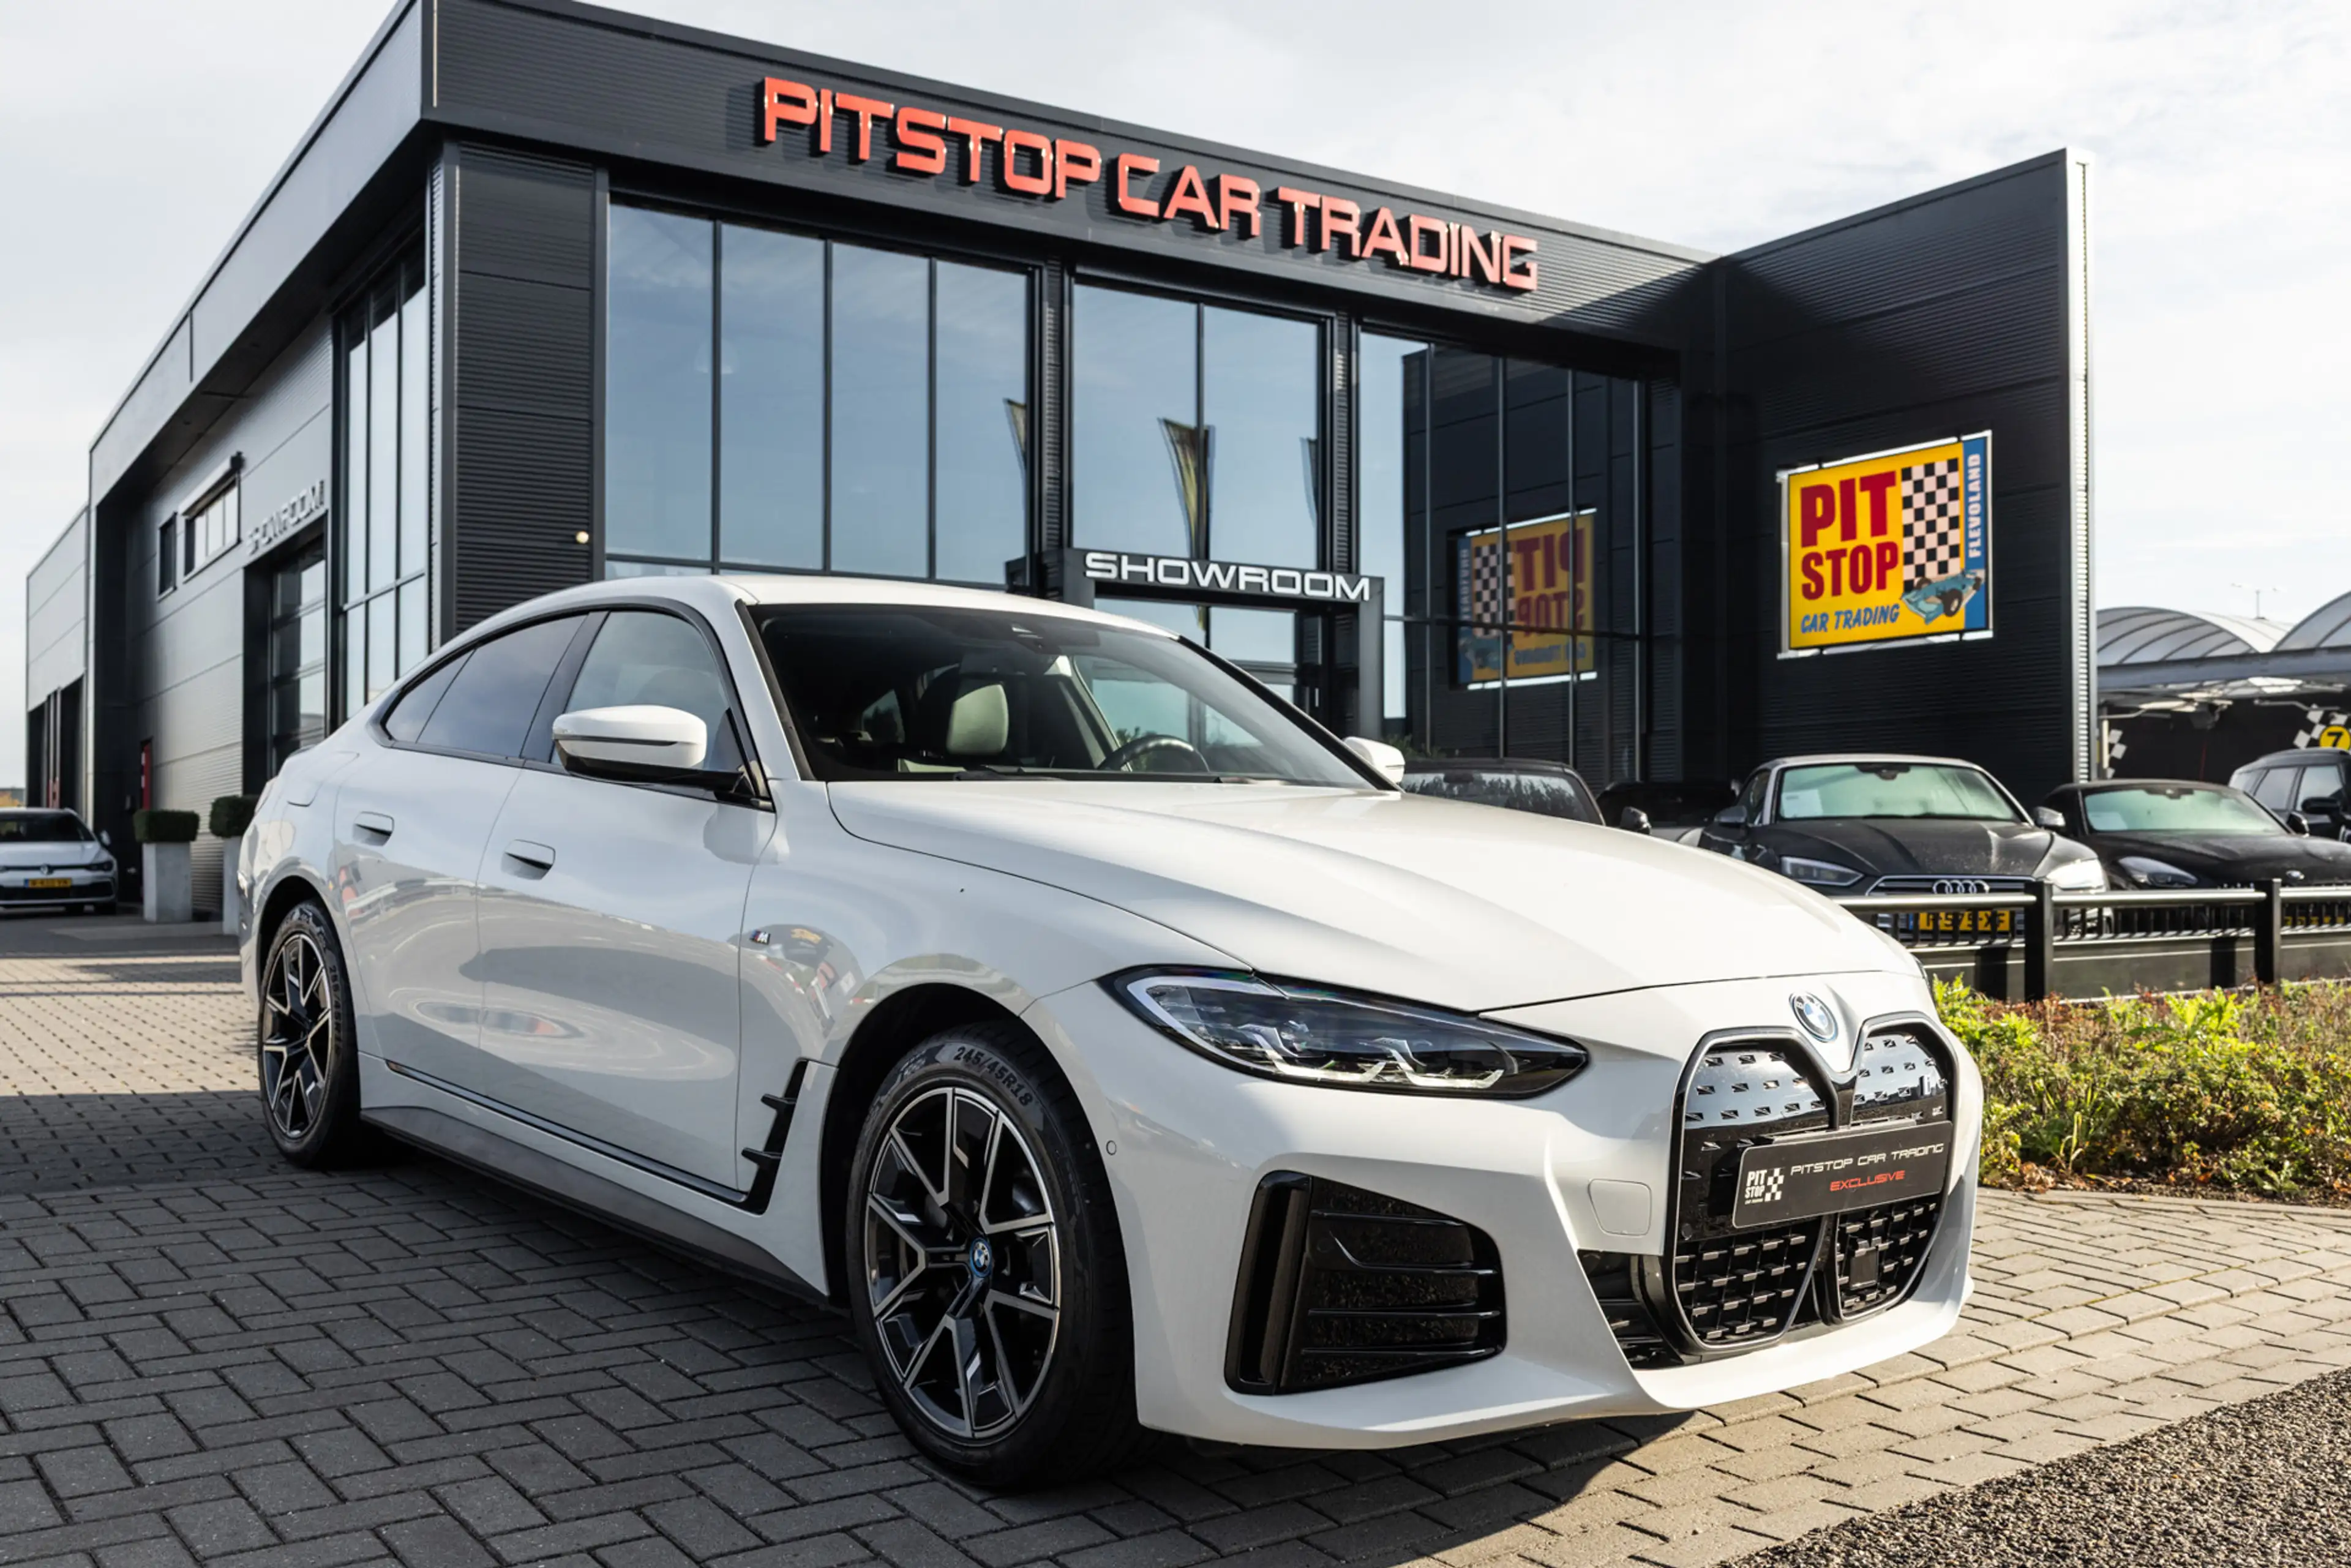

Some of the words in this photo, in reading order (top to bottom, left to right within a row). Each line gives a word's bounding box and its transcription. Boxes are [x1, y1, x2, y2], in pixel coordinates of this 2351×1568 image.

[764, 76, 1101, 198] PITSTOP
[1118, 152, 1260, 236] CAR
[1278, 186, 1538, 291] TRADING
[1801, 470, 1897, 548] PIT
[1967, 453, 1981, 558] FLEVOLAND
[1086, 552, 1370, 601] SHOWROOM
[1801, 541, 1899, 600] STOP
[1801, 613, 1829, 633] CAR
[1834, 604, 1900, 629] TRADING
[2327, 732, 2344, 747] 7
[953, 1046, 1035, 1106] 245/45R18
[1746, 1169, 1768, 1186] PIT
[1790, 1157, 1854, 1176] PITSTOP
[1857, 1152, 1887, 1166] CAR
[1890, 1142, 1944, 1160] TRADING
[1744, 1185, 1765, 1199] STOP
[1829, 1170, 1905, 1191] EXCLUSIVE
